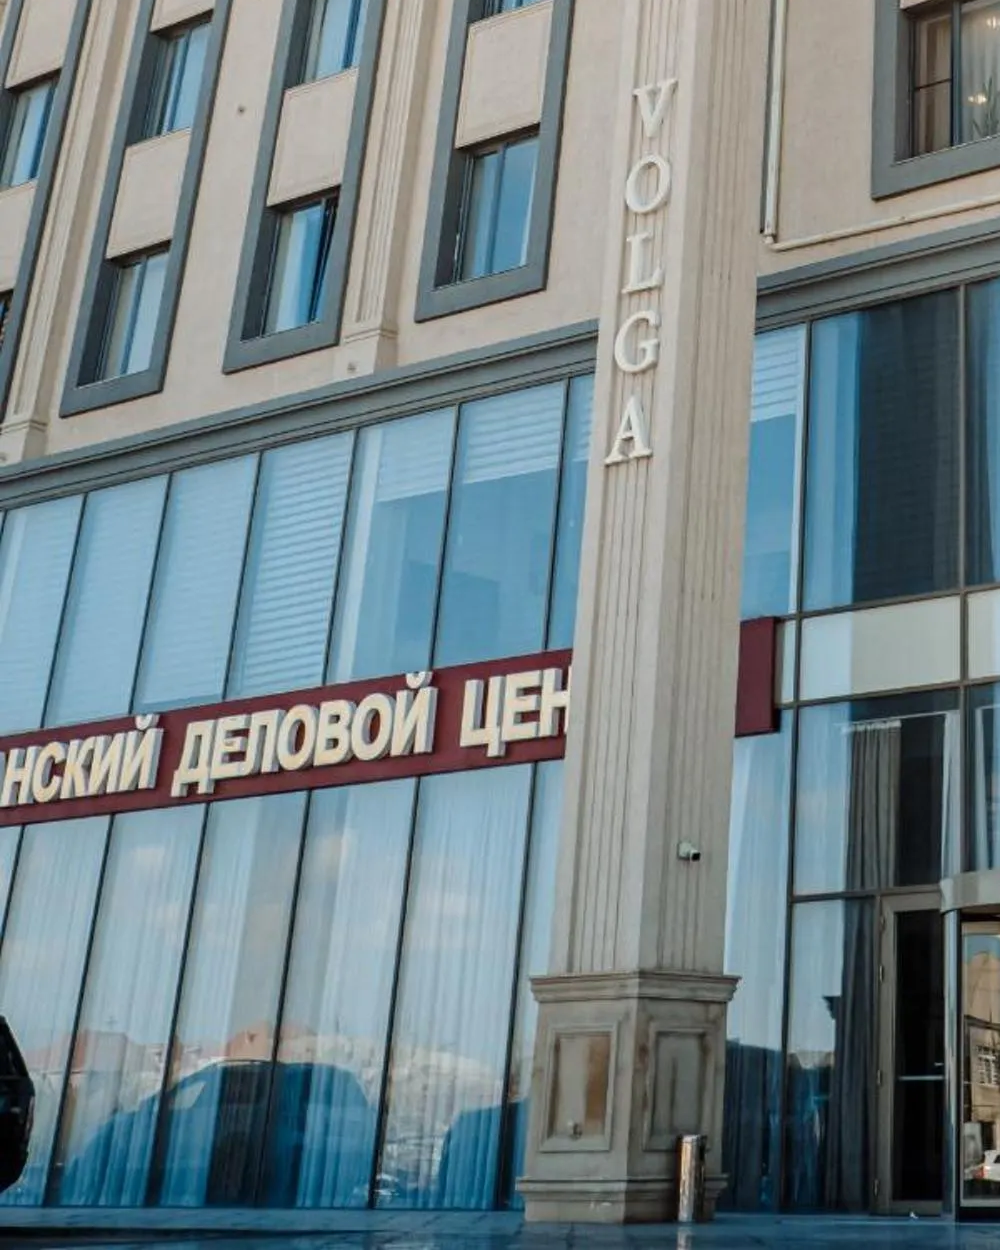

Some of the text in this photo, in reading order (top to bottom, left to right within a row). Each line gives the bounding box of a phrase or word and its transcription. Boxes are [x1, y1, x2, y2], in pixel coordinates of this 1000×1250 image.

[605, 78, 678, 465] VOLGA
[0, 713, 165, 807] НСКИЙ
[171, 671, 438, 797] ДЕЛОВОЙ
